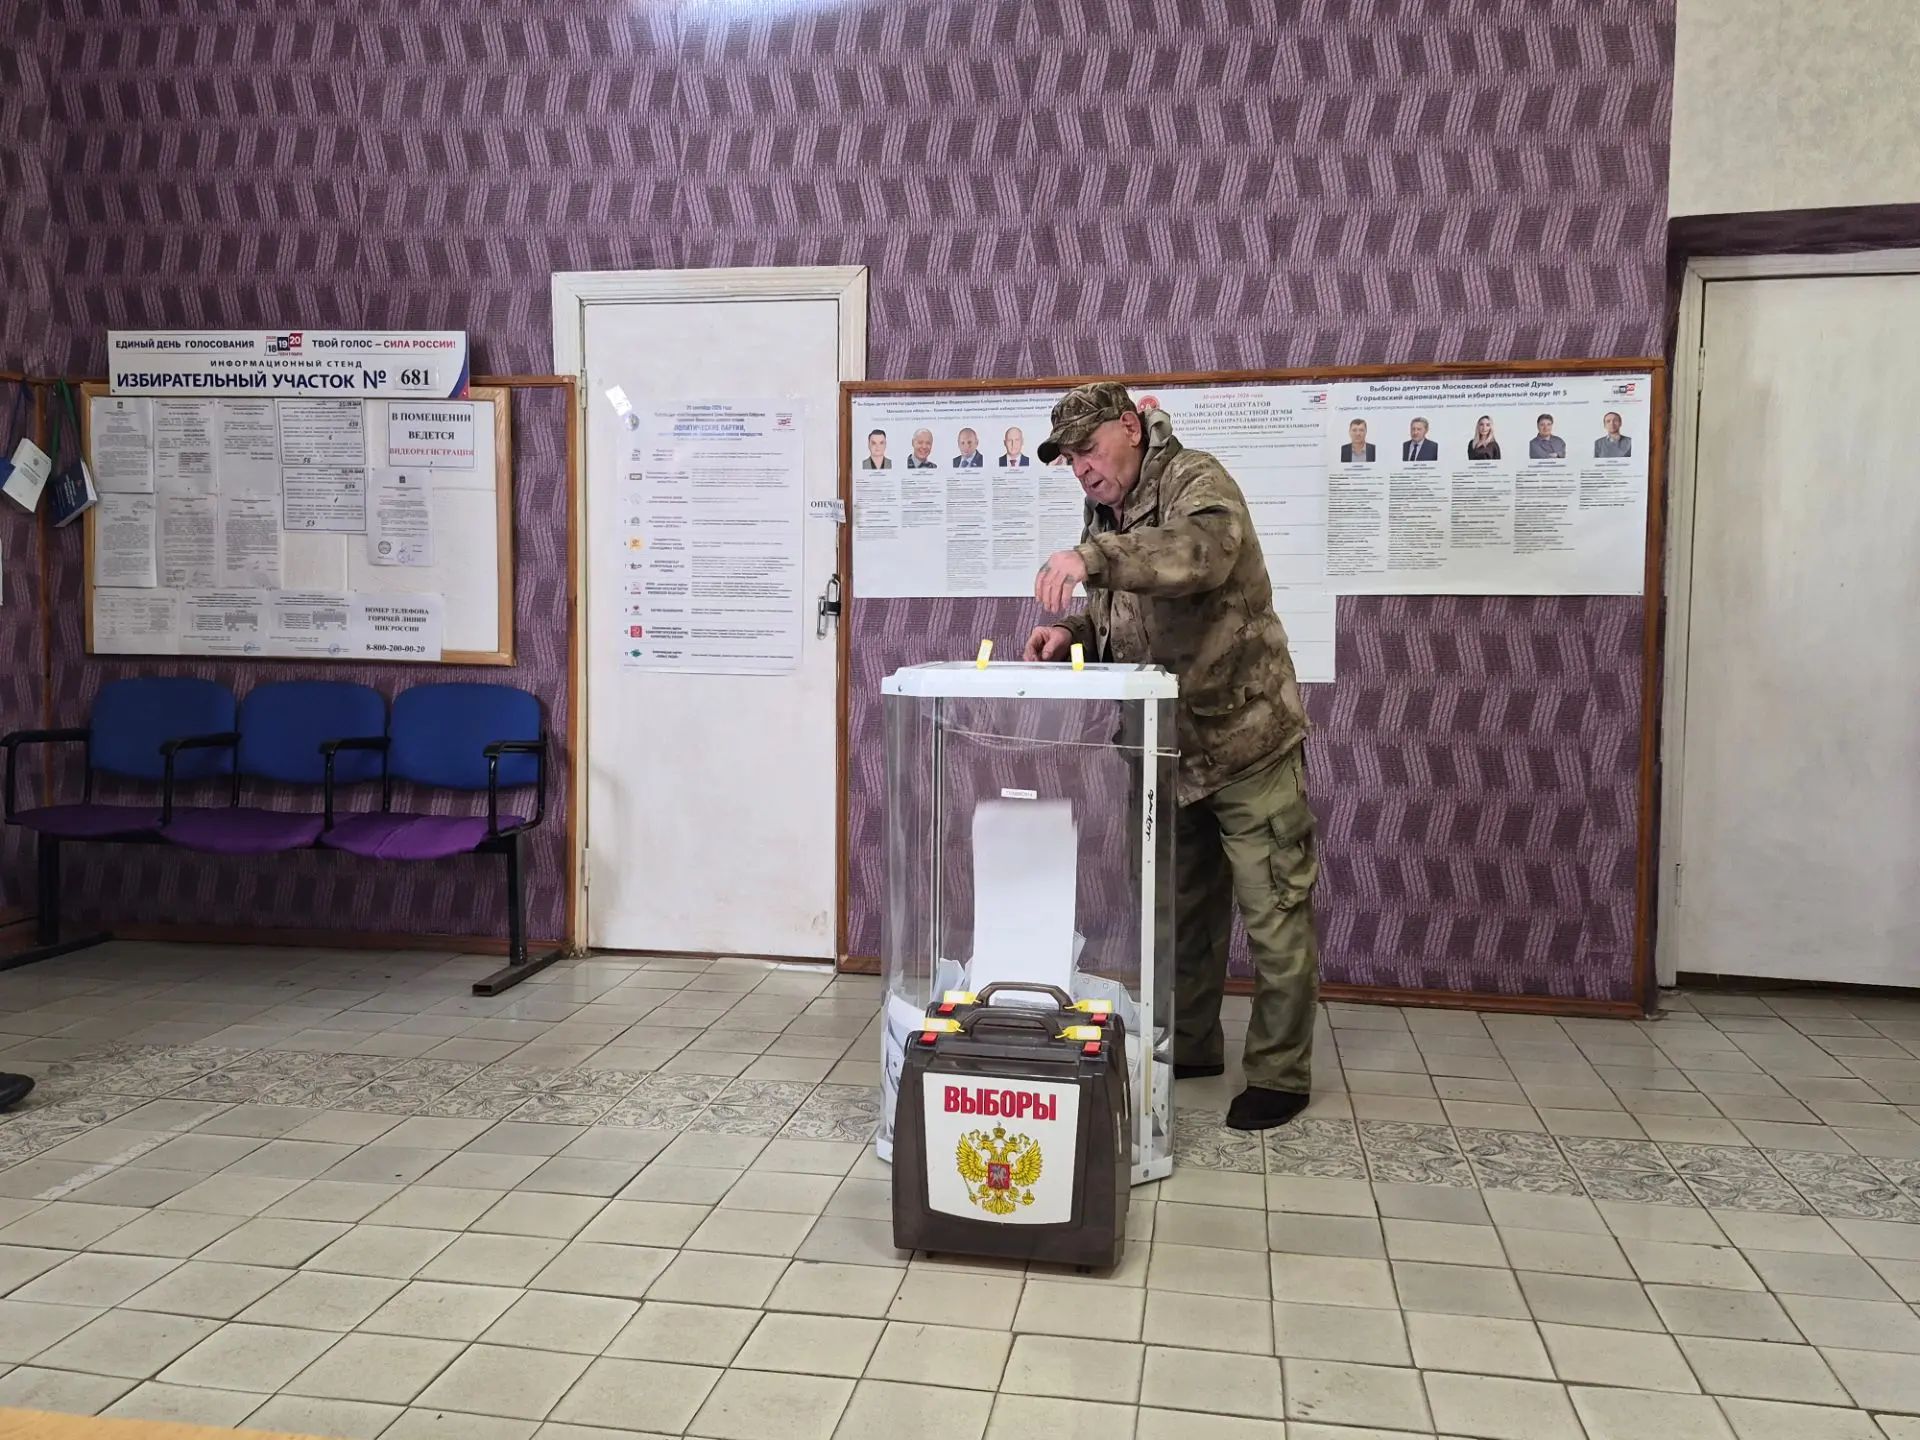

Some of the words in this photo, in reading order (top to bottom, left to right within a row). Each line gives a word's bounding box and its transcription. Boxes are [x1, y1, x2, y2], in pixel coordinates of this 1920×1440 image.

[115, 338, 155, 350] ЕДИНЫЙ
[156, 340, 181, 350] ДЕНЬ
[185, 340, 255, 349] ГОЛОСОВАНИЯ
[312, 337, 338, 348] ТВОЙ
[340, 339, 373, 348] ГОЛОС
[383, 340, 410, 349] СИЛА
[412, 340, 456, 349] РОССИИ!
[210, 359, 322, 368] ИНФОРМАЦИОННЫЙ
[327, 360, 363, 369] СТЕНД
[116, 370, 267, 388] ИЗБИРАТЕЛЬНЫЙ
[272, 373, 355, 389] УЧАСТОК
[363, 369, 387, 389] №
[400, 368, 430, 386] 681
[1370, 385, 1401, 393] Выборы
[1402, 383, 1440, 392] депутатов
[1442, 382, 1488, 390] Московской
[1489, 380, 1529, 389] областной
[1530, 380, 1554, 388] Думы
[1356, 394, 1403, 402] Егорьевский
[1467, 390, 1528, 399] избирательный
[1529, 390, 1551, 399] округ
[391, 412, 398, 421] В
[400, 412, 471, 423] ПОМЕЩЕНИИ
[408, 430, 455, 441] ВЕДЕТСЯ
[366, 643, 426, 653] 8-800-200-00-20
[944, 1086, 1057, 1121] ВЫБОРЫ
